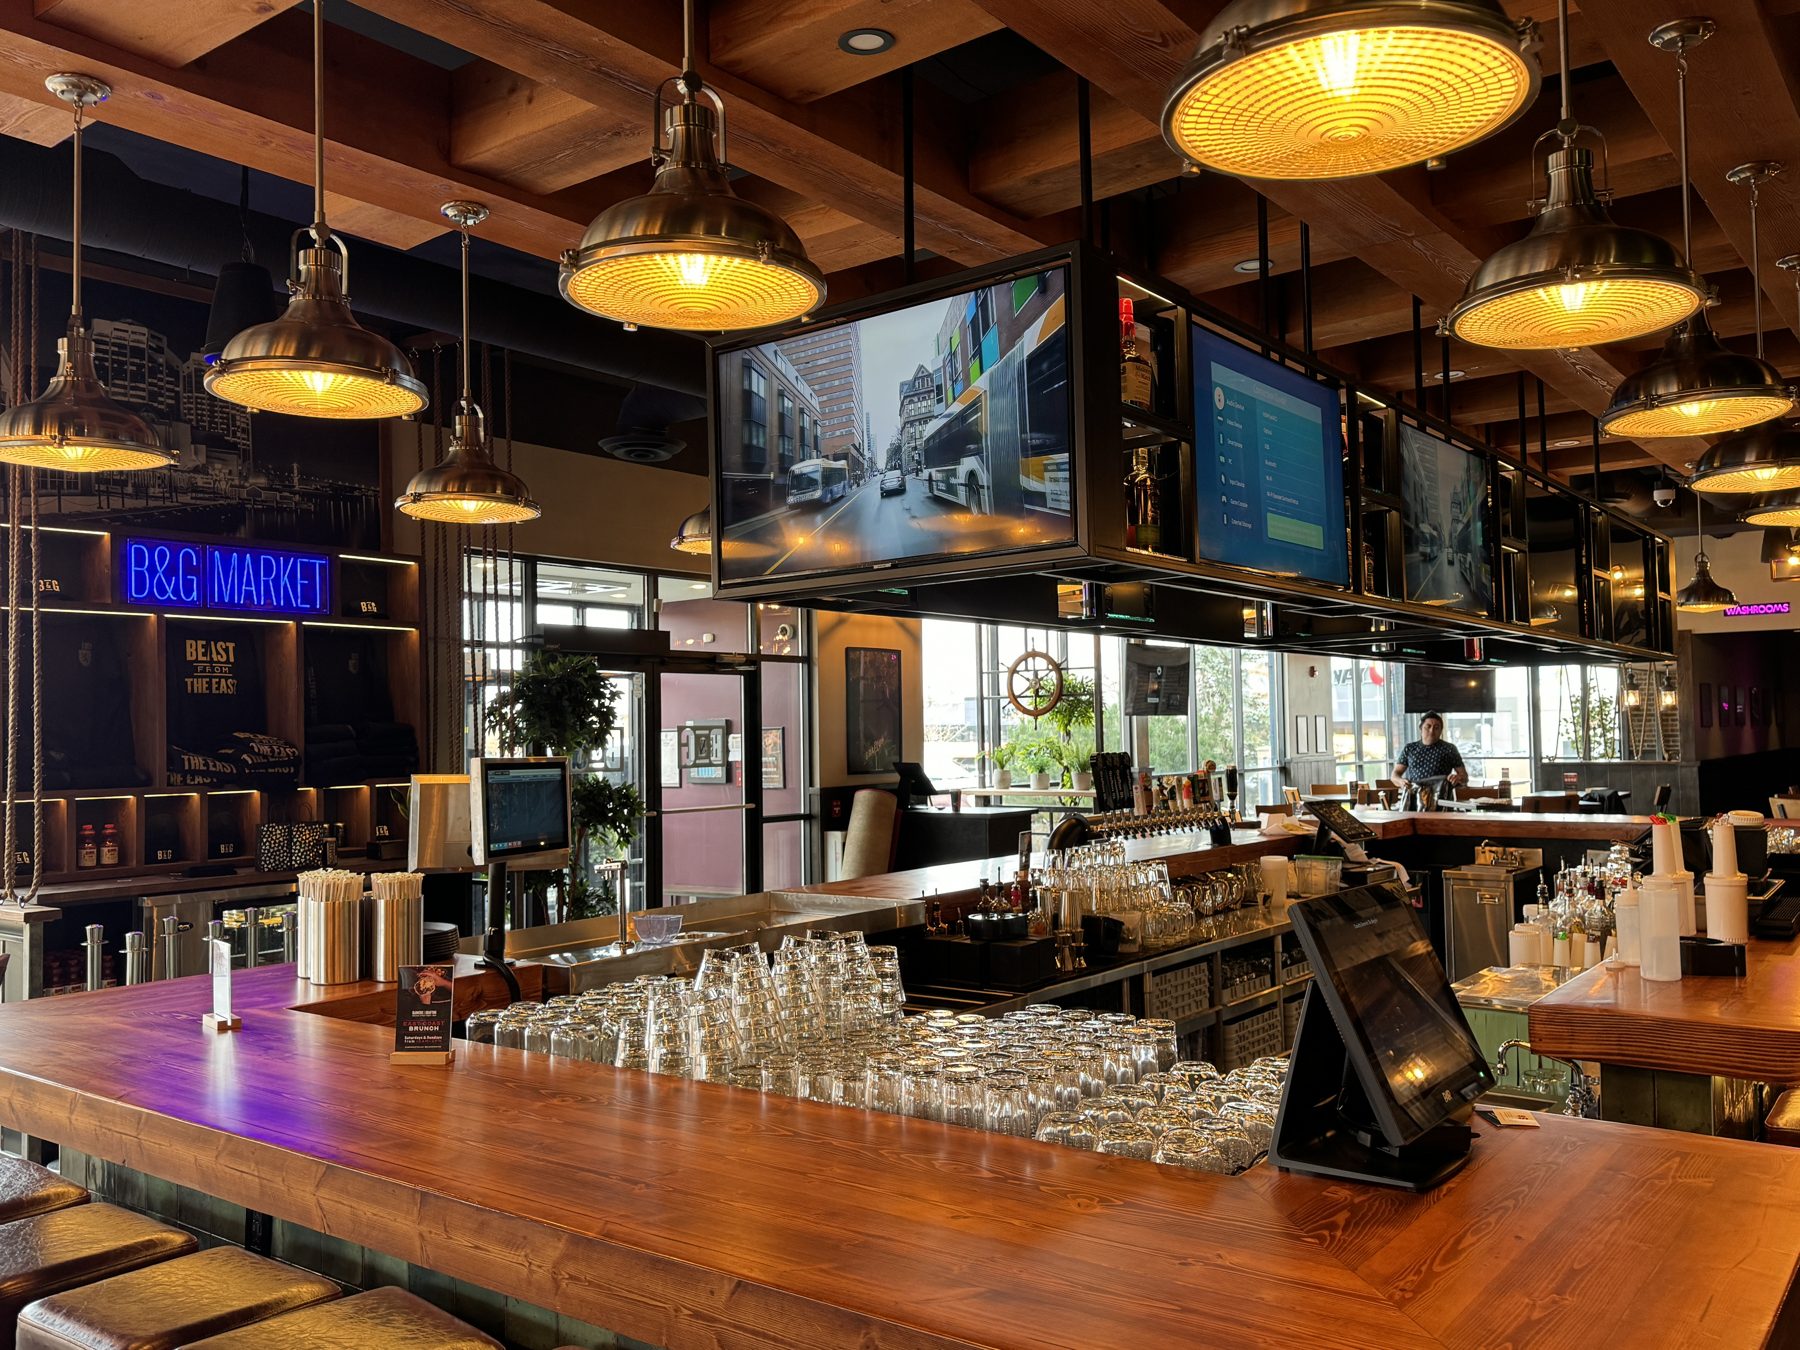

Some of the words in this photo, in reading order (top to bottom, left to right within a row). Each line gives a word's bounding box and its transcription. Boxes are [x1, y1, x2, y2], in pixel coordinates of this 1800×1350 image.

[131, 544, 198, 602] B&G
[214, 550, 326, 609] MARKET
[1726, 603, 1789, 615] WASHROOMS
[185, 639, 236, 663] BEAST
[197, 665, 229, 674] FROM
[184, 678, 210, 694] THE
